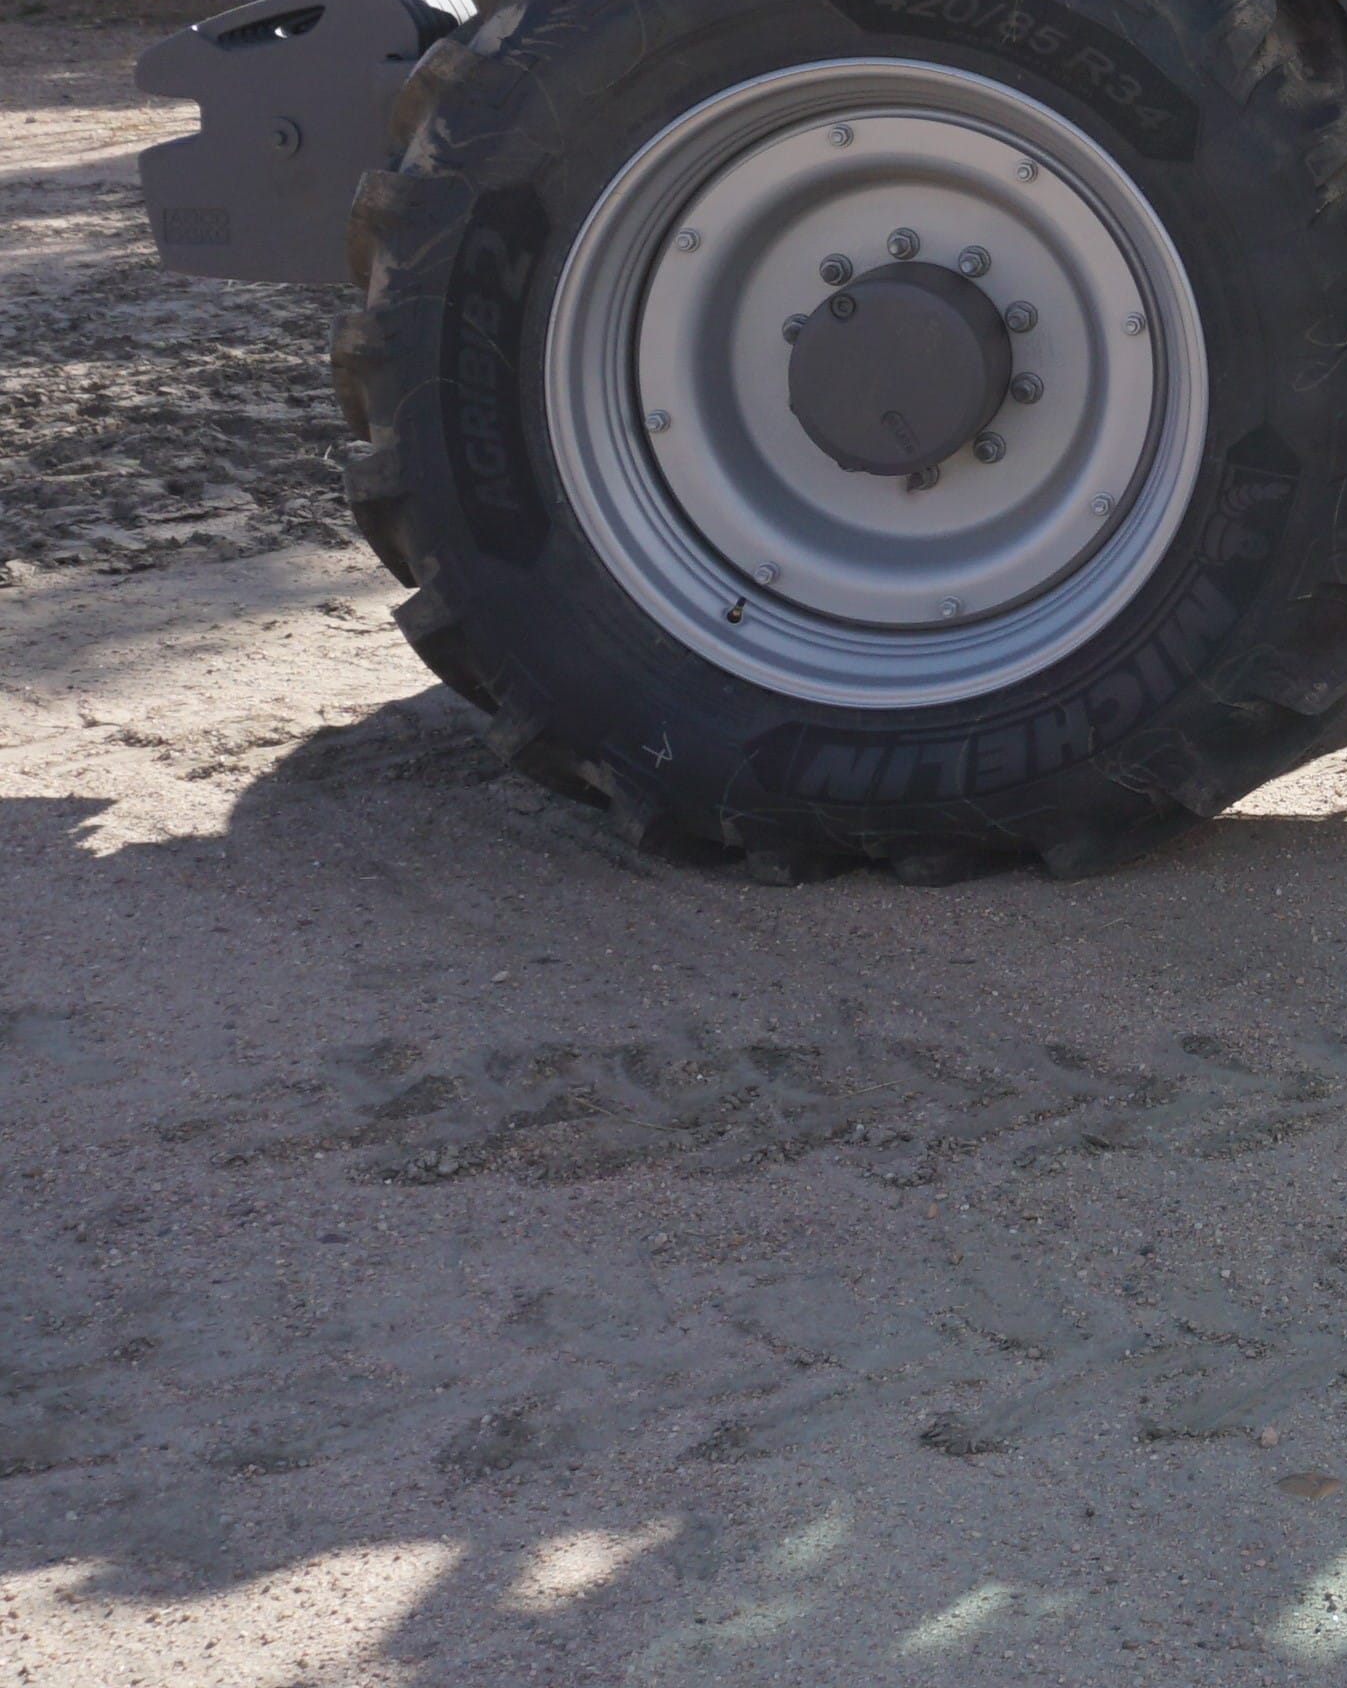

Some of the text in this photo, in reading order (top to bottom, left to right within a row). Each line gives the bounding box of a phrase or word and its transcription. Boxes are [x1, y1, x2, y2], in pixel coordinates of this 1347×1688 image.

[1066, 45, 1169, 131] R34
[460, 227, 534, 512] AGRIBIB 2
[799, 571, 1242, 801] MICHELIN
